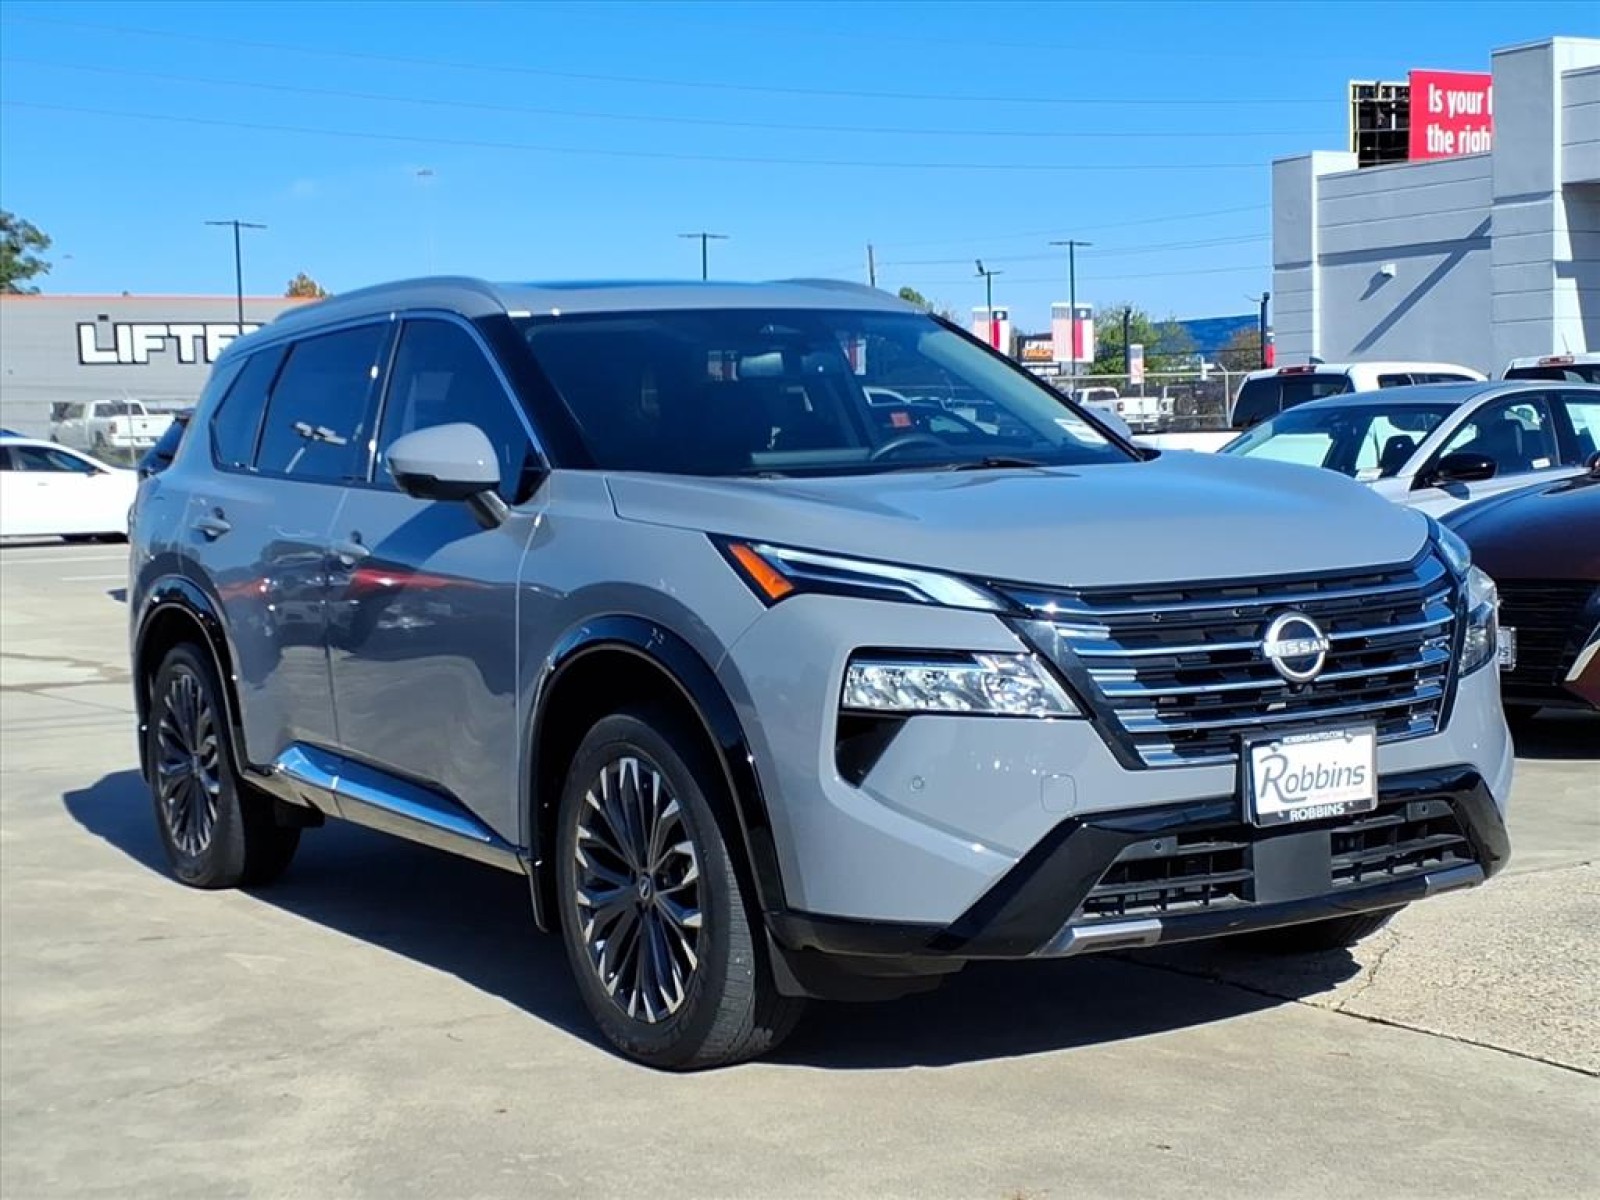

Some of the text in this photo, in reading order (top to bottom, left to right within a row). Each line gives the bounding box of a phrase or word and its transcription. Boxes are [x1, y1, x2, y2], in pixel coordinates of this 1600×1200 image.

[1428, 83, 1443, 113] Is
[1446, 89, 1484, 119] your
[1426, 123, 1454, 153] the
[77, 322, 265, 364] LIFTE
[1259, 753, 1366, 803] Robbins
[1289, 803, 1345, 822] ROBBINS
